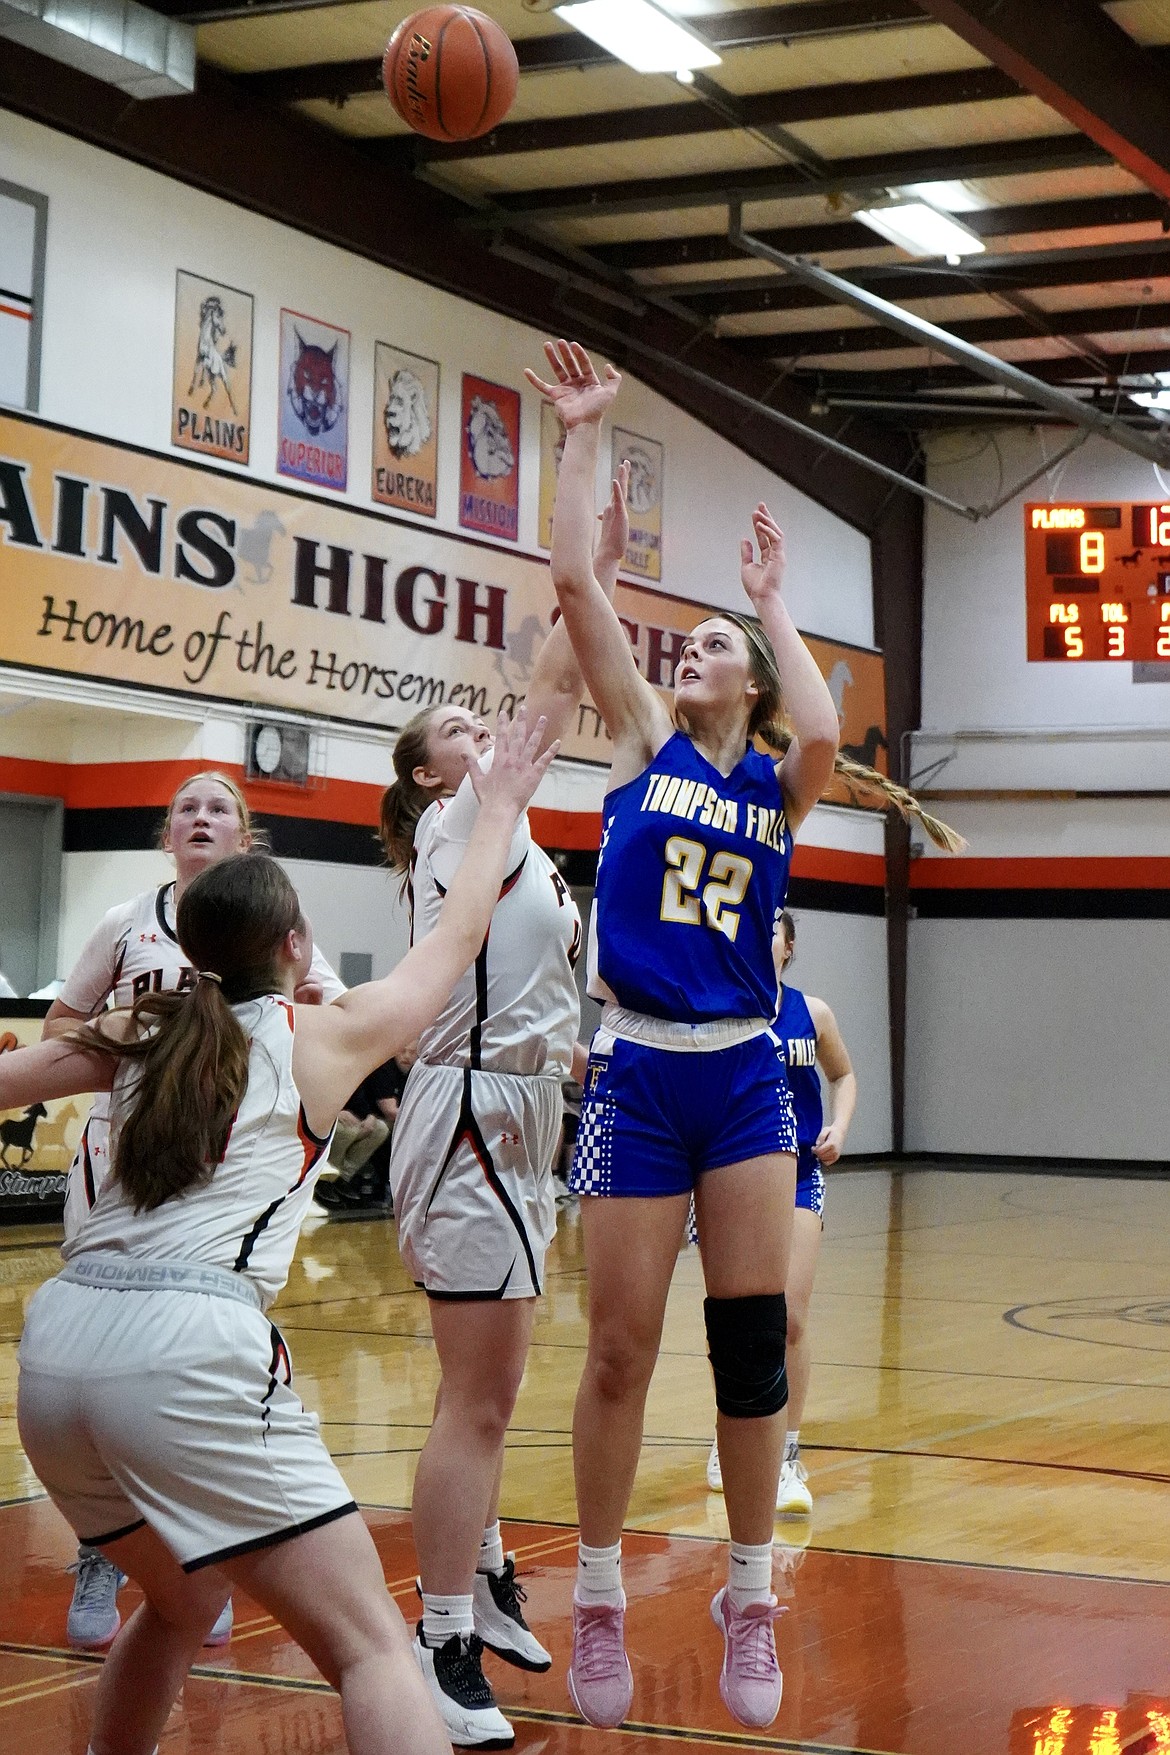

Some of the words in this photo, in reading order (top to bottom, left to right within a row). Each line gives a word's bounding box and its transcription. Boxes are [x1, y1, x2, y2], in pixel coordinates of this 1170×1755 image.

[177, 407, 246, 452] PLAINS
[281, 438, 343, 480] SUPERIOR
[375, 467, 434, 507] EUREKA
[463, 493, 517, 529] MISSION
[1031, 508, 1086, 529] PLAINS
[1079, 531, 1105, 574] 8
[290, 536, 508, 651] HIGH
[37, 595, 174, 656] Home
[184, 611, 231, 684] of
[235, 620, 297, 679] the
[306, 650, 490, 717] Horsemen
[1064, 626, 1084, 657] 5
[1108, 626, 1124, 657] 3
[640, 774, 738, 834] THOMPSON
[660, 836, 752, 943] 22
